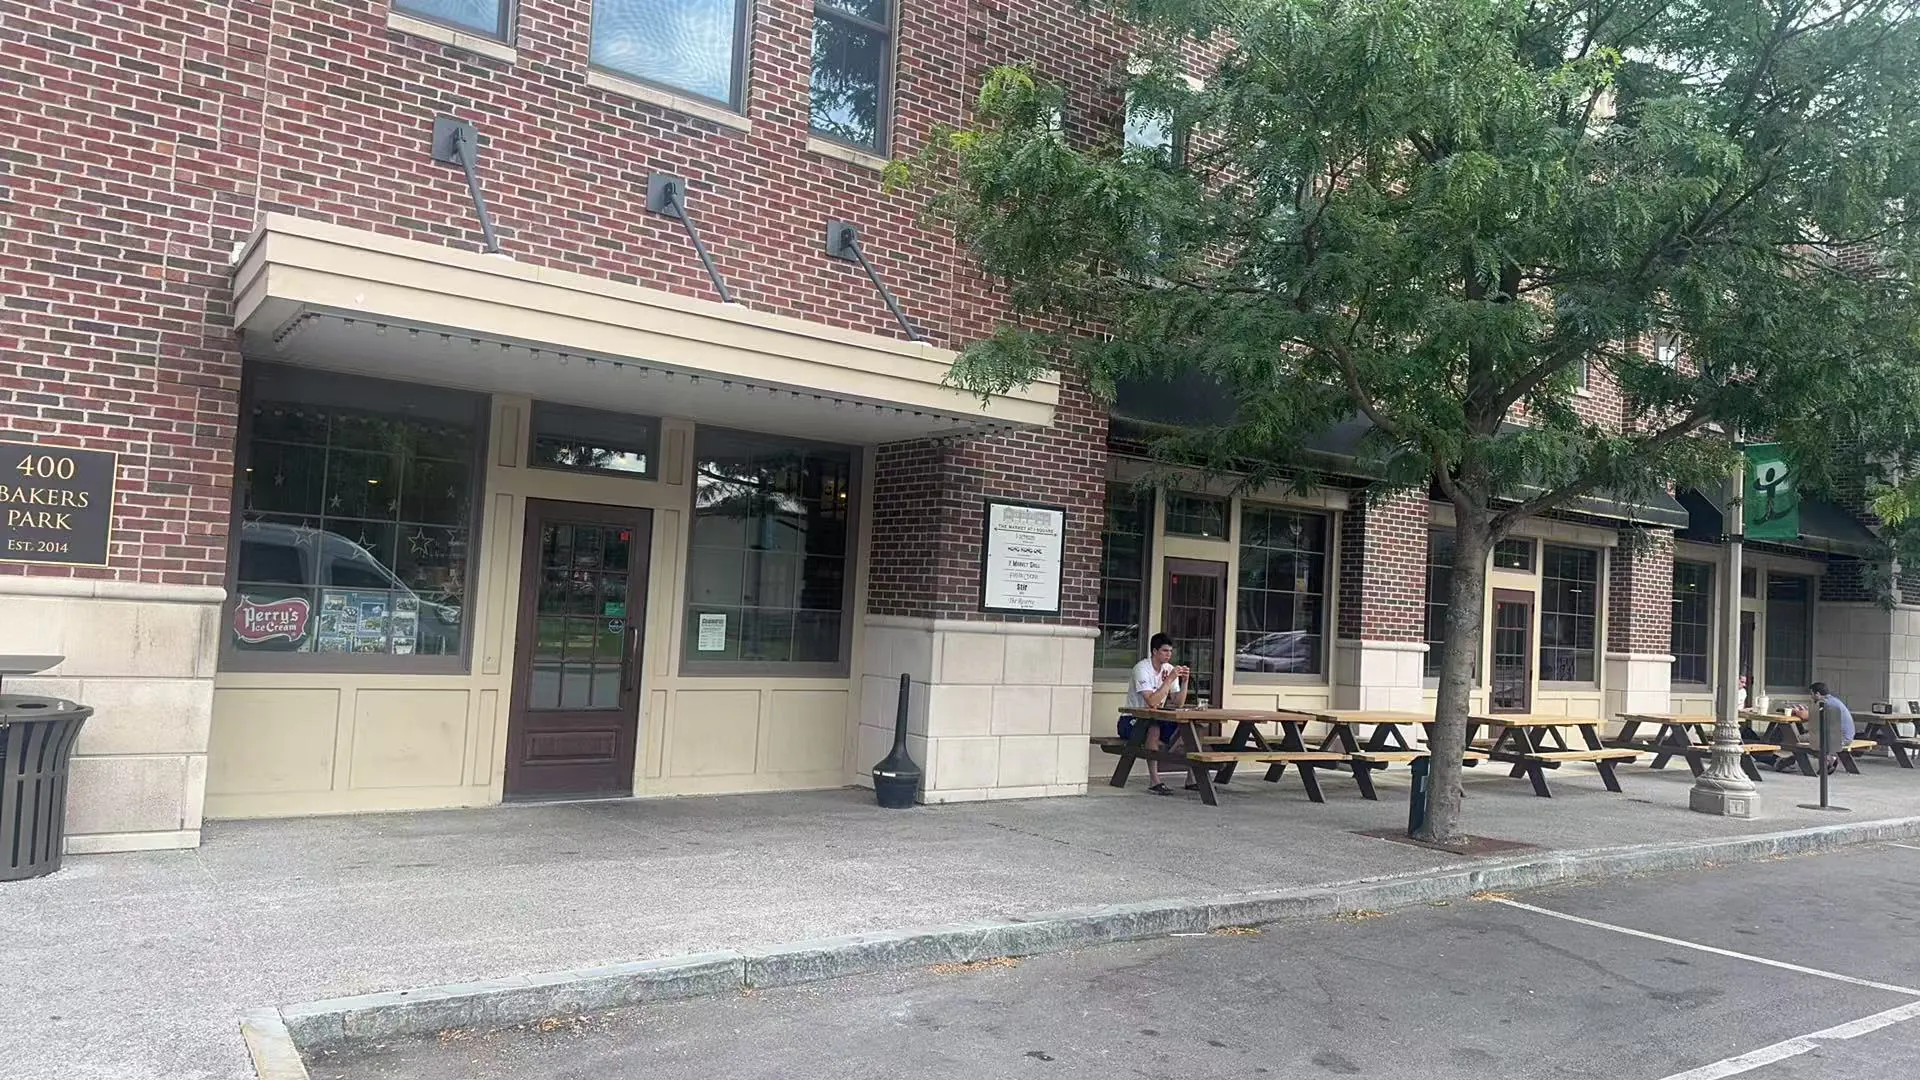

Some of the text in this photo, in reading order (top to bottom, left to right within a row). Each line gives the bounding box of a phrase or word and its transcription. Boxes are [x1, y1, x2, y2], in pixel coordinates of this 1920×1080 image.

[15, 453, 76, 480] 400
[0, 485, 89, 508] BAKERS
[7, 509, 73, 531] PARK
[37, 541, 69, 553] 2014
[242, 606, 300, 629] Perry's
[251, 621, 297, 632] Ice Cream
